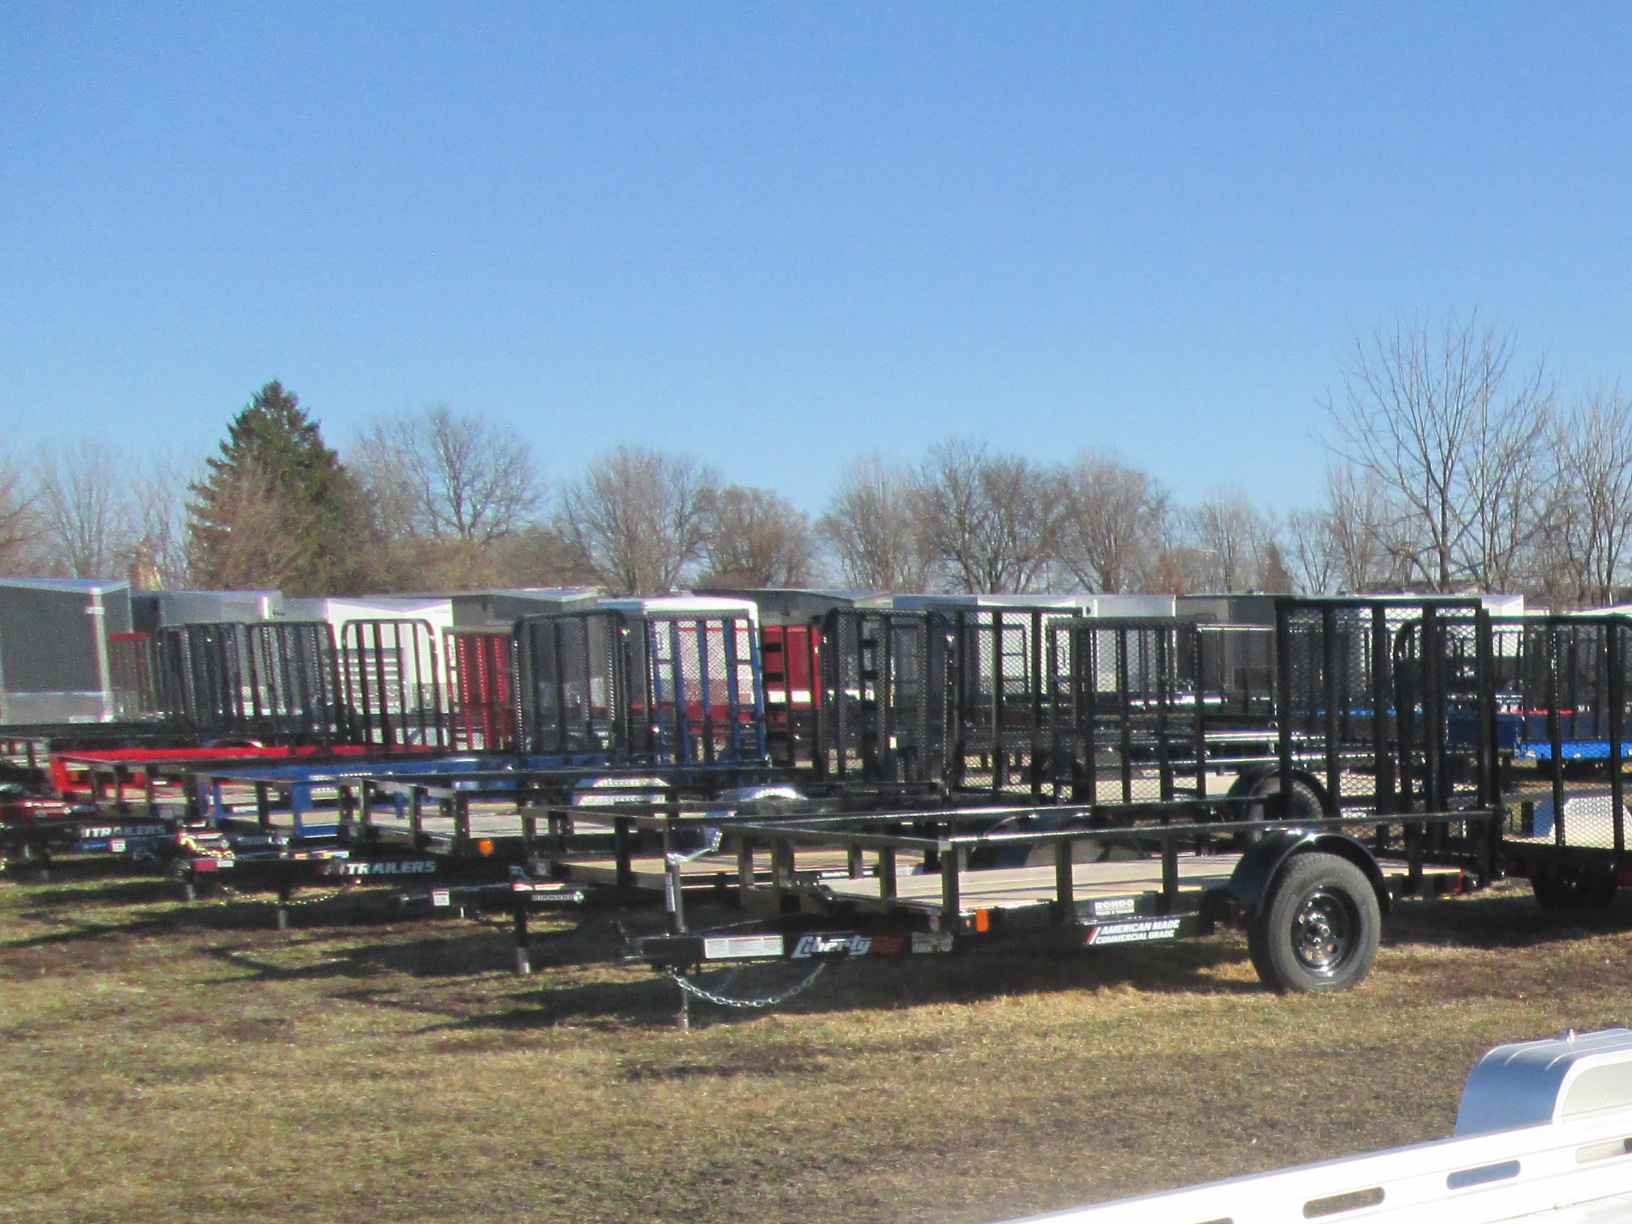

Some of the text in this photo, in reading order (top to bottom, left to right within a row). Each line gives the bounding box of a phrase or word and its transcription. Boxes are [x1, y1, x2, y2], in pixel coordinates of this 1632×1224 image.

[346, 861, 437, 875] TRAILERS
[1095, 899, 1135, 910] RONDO
[1101, 919, 1181, 935] AMERICAN MADE
[1096, 929, 1175, 944] COMMERCIAL GRADE
[791, 935, 873, 959] Liberty
